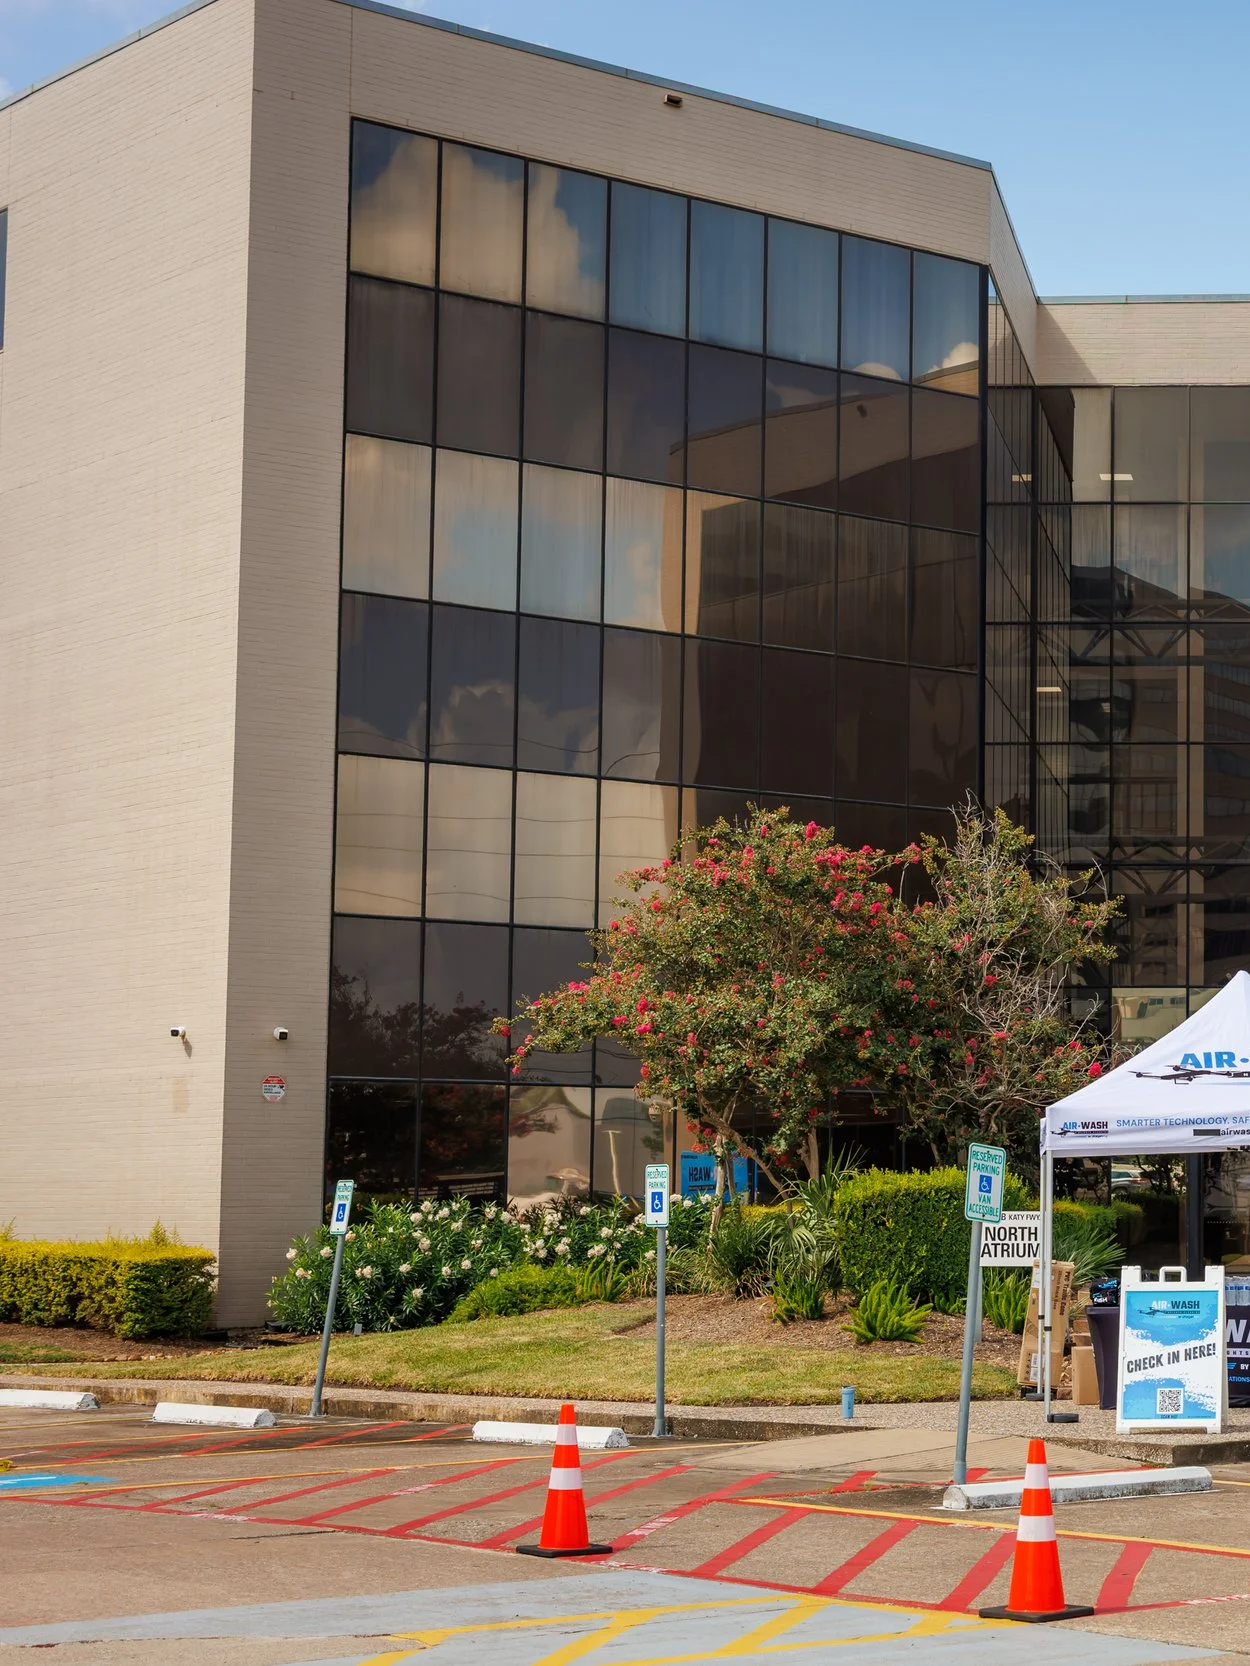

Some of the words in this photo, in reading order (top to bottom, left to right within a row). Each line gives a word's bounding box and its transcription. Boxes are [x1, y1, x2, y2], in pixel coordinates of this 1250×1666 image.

[1116, 1119, 1161, 1127] SMARTER
[1164, 1117, 1230, 1126] TECHNOLOGY.
[971, 1150, 1003, 1164] RESERVED
[972, 1162, 1000, 1176] PARKING
[978, 1193, 992, 1204] VAN
[968, 1203, 999, 1218] ACCESSIBLE
[1009, 1213, 1025, 1221] KATY
[1026, 1213, 1040, 1221] FWY
[985, 1226, 1038, 1242] NORTH
[1127, 1354, 1164, 1374] CHECK
[1167, 1352, 1180, 1365] IN
[1184, 1343, 1216, 1361] HERE!
